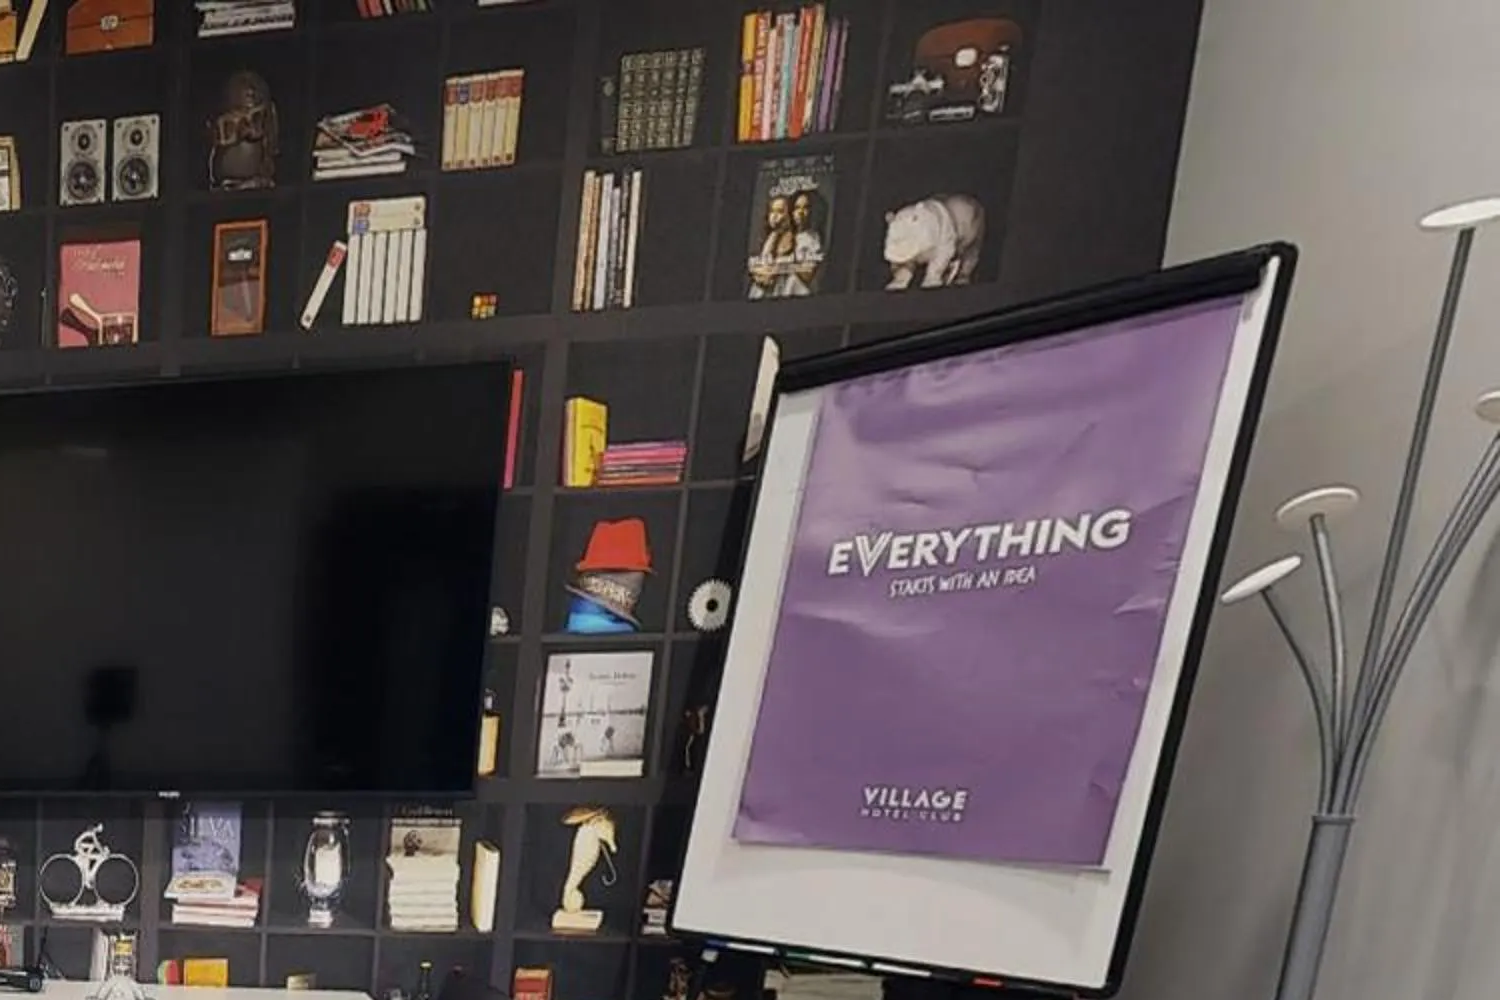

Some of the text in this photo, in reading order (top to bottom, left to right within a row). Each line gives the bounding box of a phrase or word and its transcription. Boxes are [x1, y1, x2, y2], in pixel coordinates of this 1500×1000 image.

[827, 508, 1132, 577] EVERYTHING
[939, 571, 972, 592] WITH
[976, 569, 999, 588] AN
[1003, 566, 1036, 586] IDEA
[863, 786, 968, 811] VILLAGE
